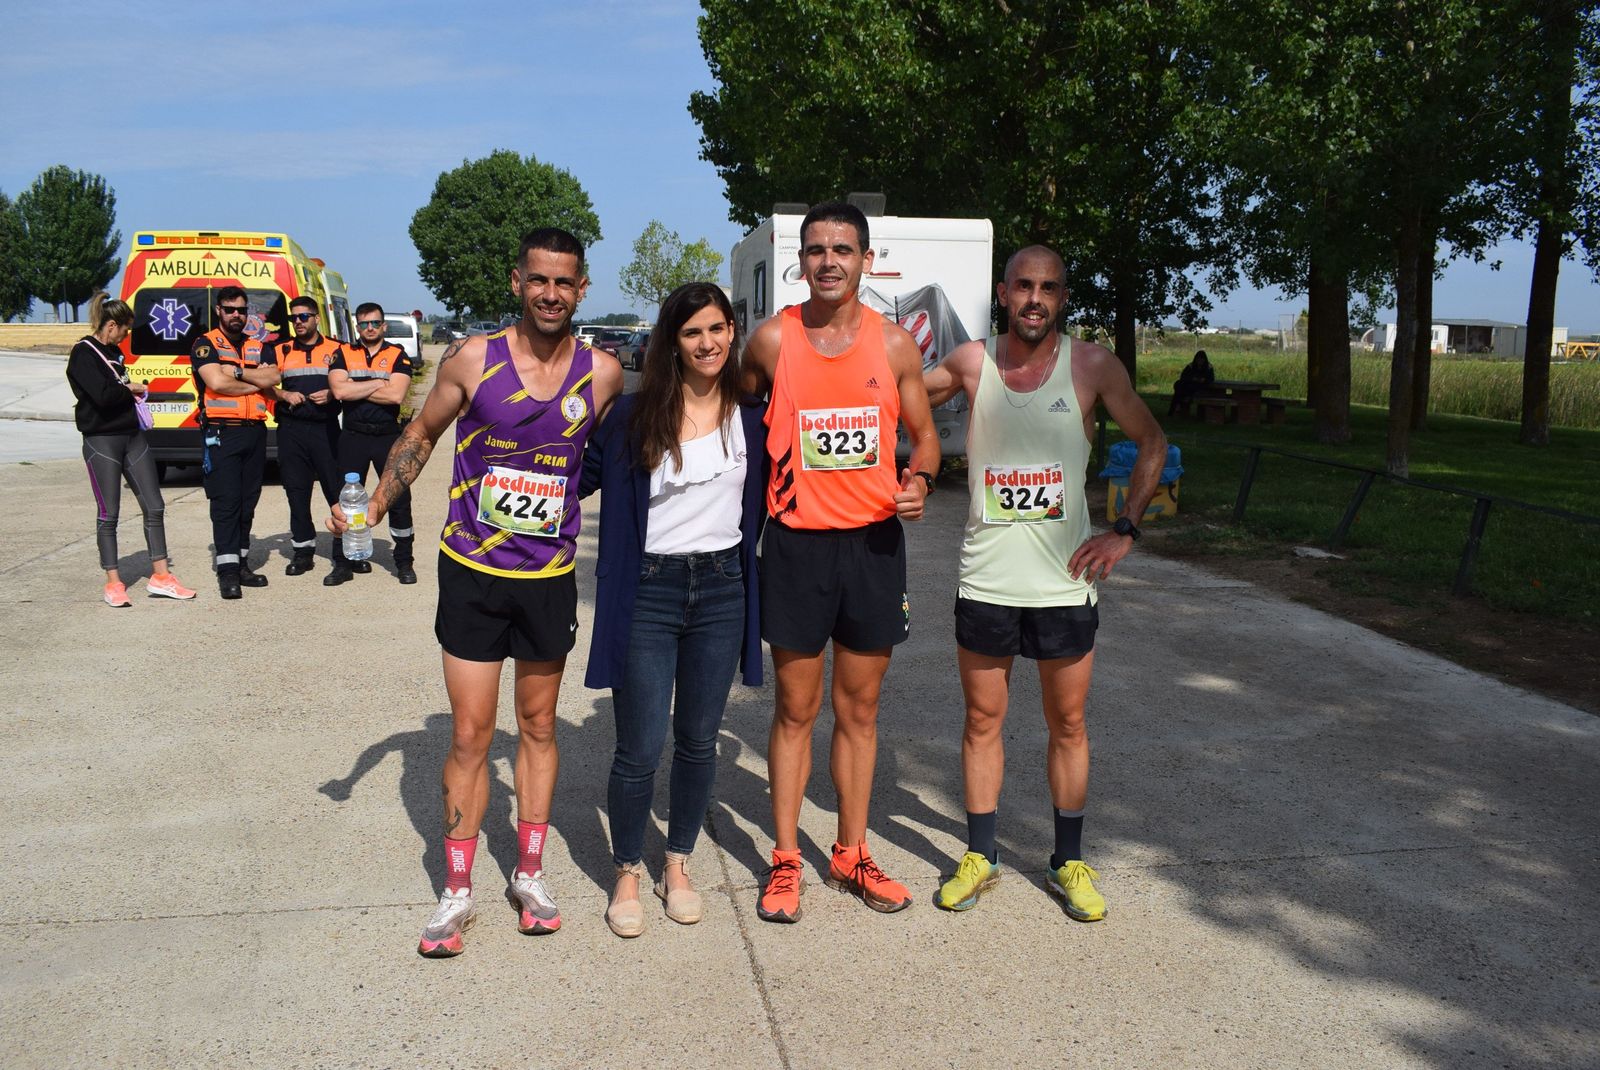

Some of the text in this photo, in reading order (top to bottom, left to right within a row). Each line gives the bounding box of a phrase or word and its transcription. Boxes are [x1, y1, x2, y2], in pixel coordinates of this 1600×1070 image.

[147, 261, 272, 278] AMBULANCIA
[126, 366, 182, 376] Protección
[171, 404, 189, 413] HYG
[801, 412, 878, 431] bedunia
[485, 435, 518, 449] Jamón
[817, 431, 866, 455] 323
[534, 453, 567, 468] PRIM
[484, 473, 565, 498] bedunia
[984, 469, 1062, 487] bedunia
[495, 492, 548, 521] 424
[1000, 487, 1050, 510] 324
[528, 830, 542, 855] JORGE
[451, 847, 466, 873] JORGE
